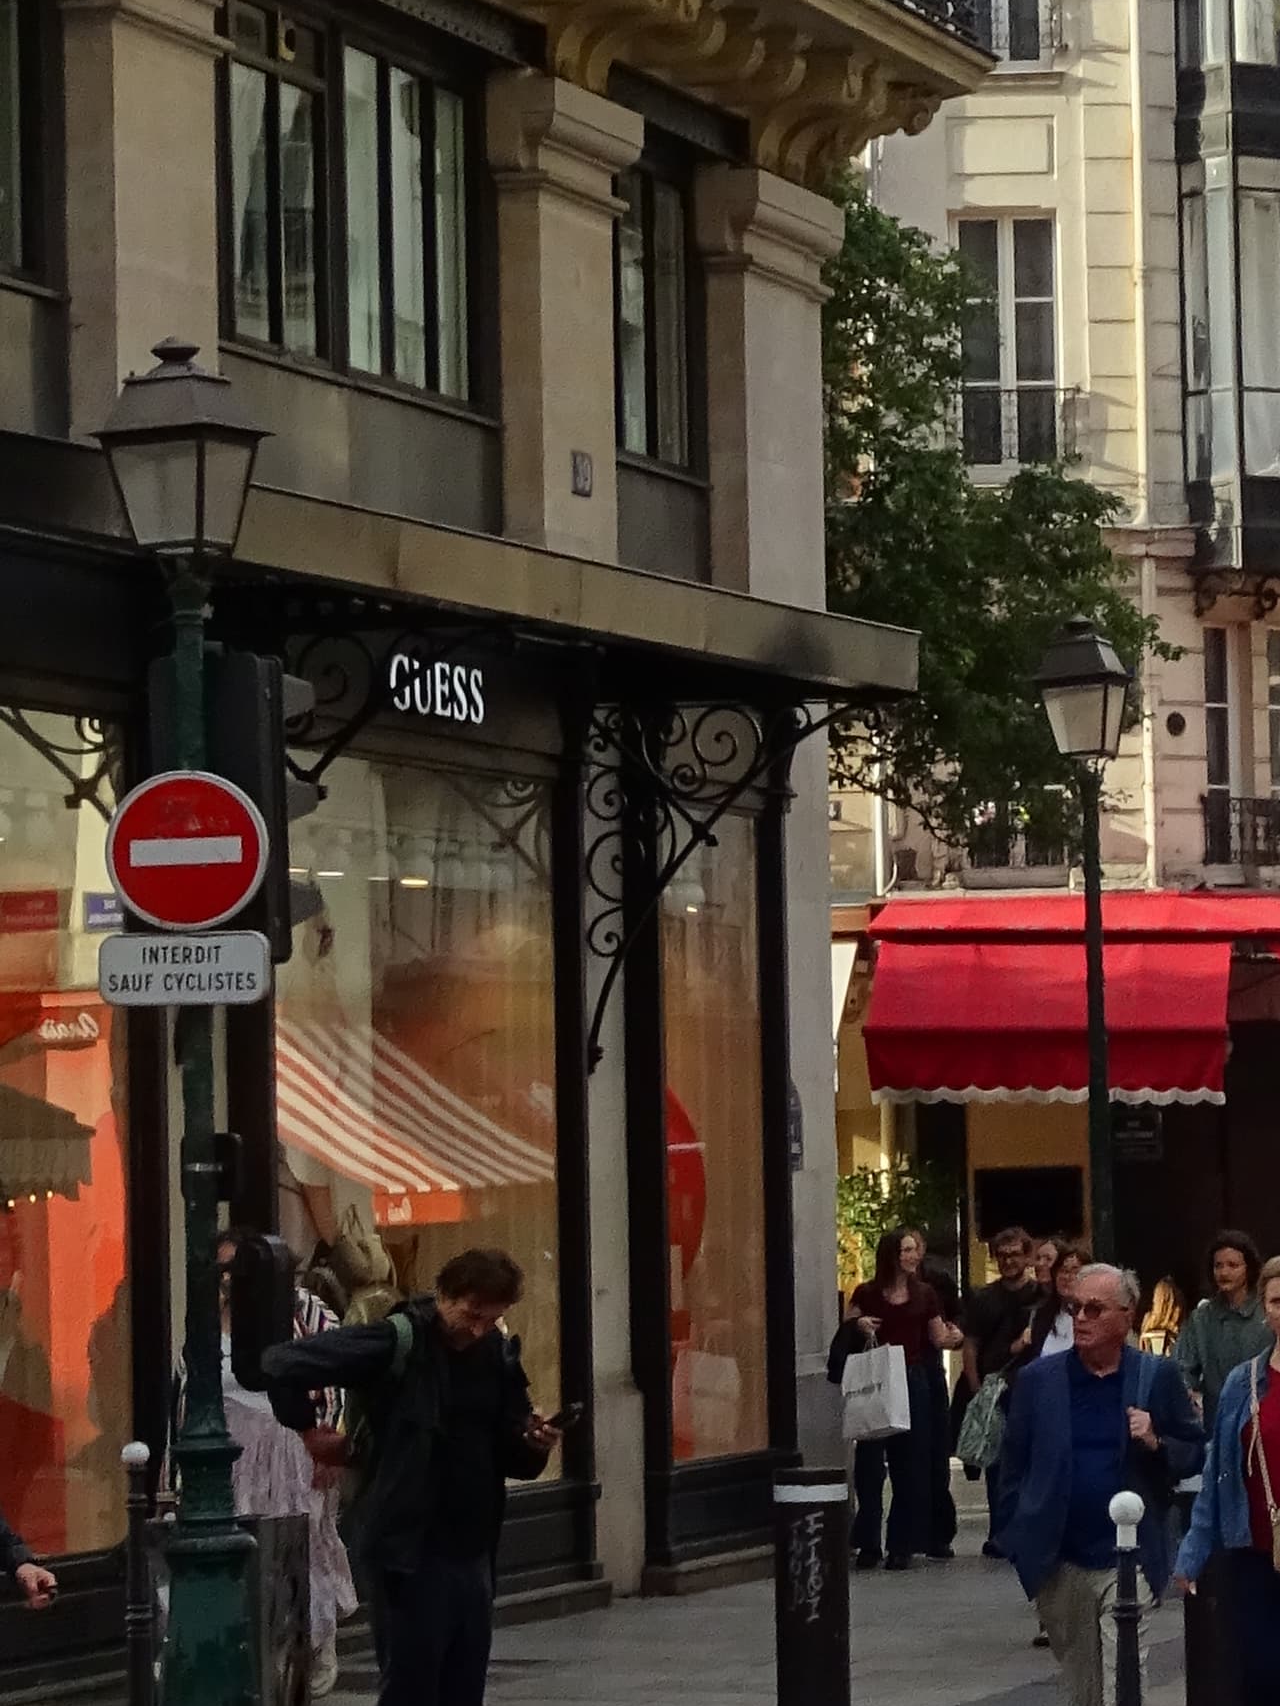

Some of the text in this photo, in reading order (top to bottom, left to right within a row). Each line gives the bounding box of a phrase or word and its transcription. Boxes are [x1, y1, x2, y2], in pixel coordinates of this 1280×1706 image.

[389, 653, 485, 725] GUESS
[141, 945, 222, 965] INTERDIT
[108, 972, 257, 993] SAUF CYCLISTES
